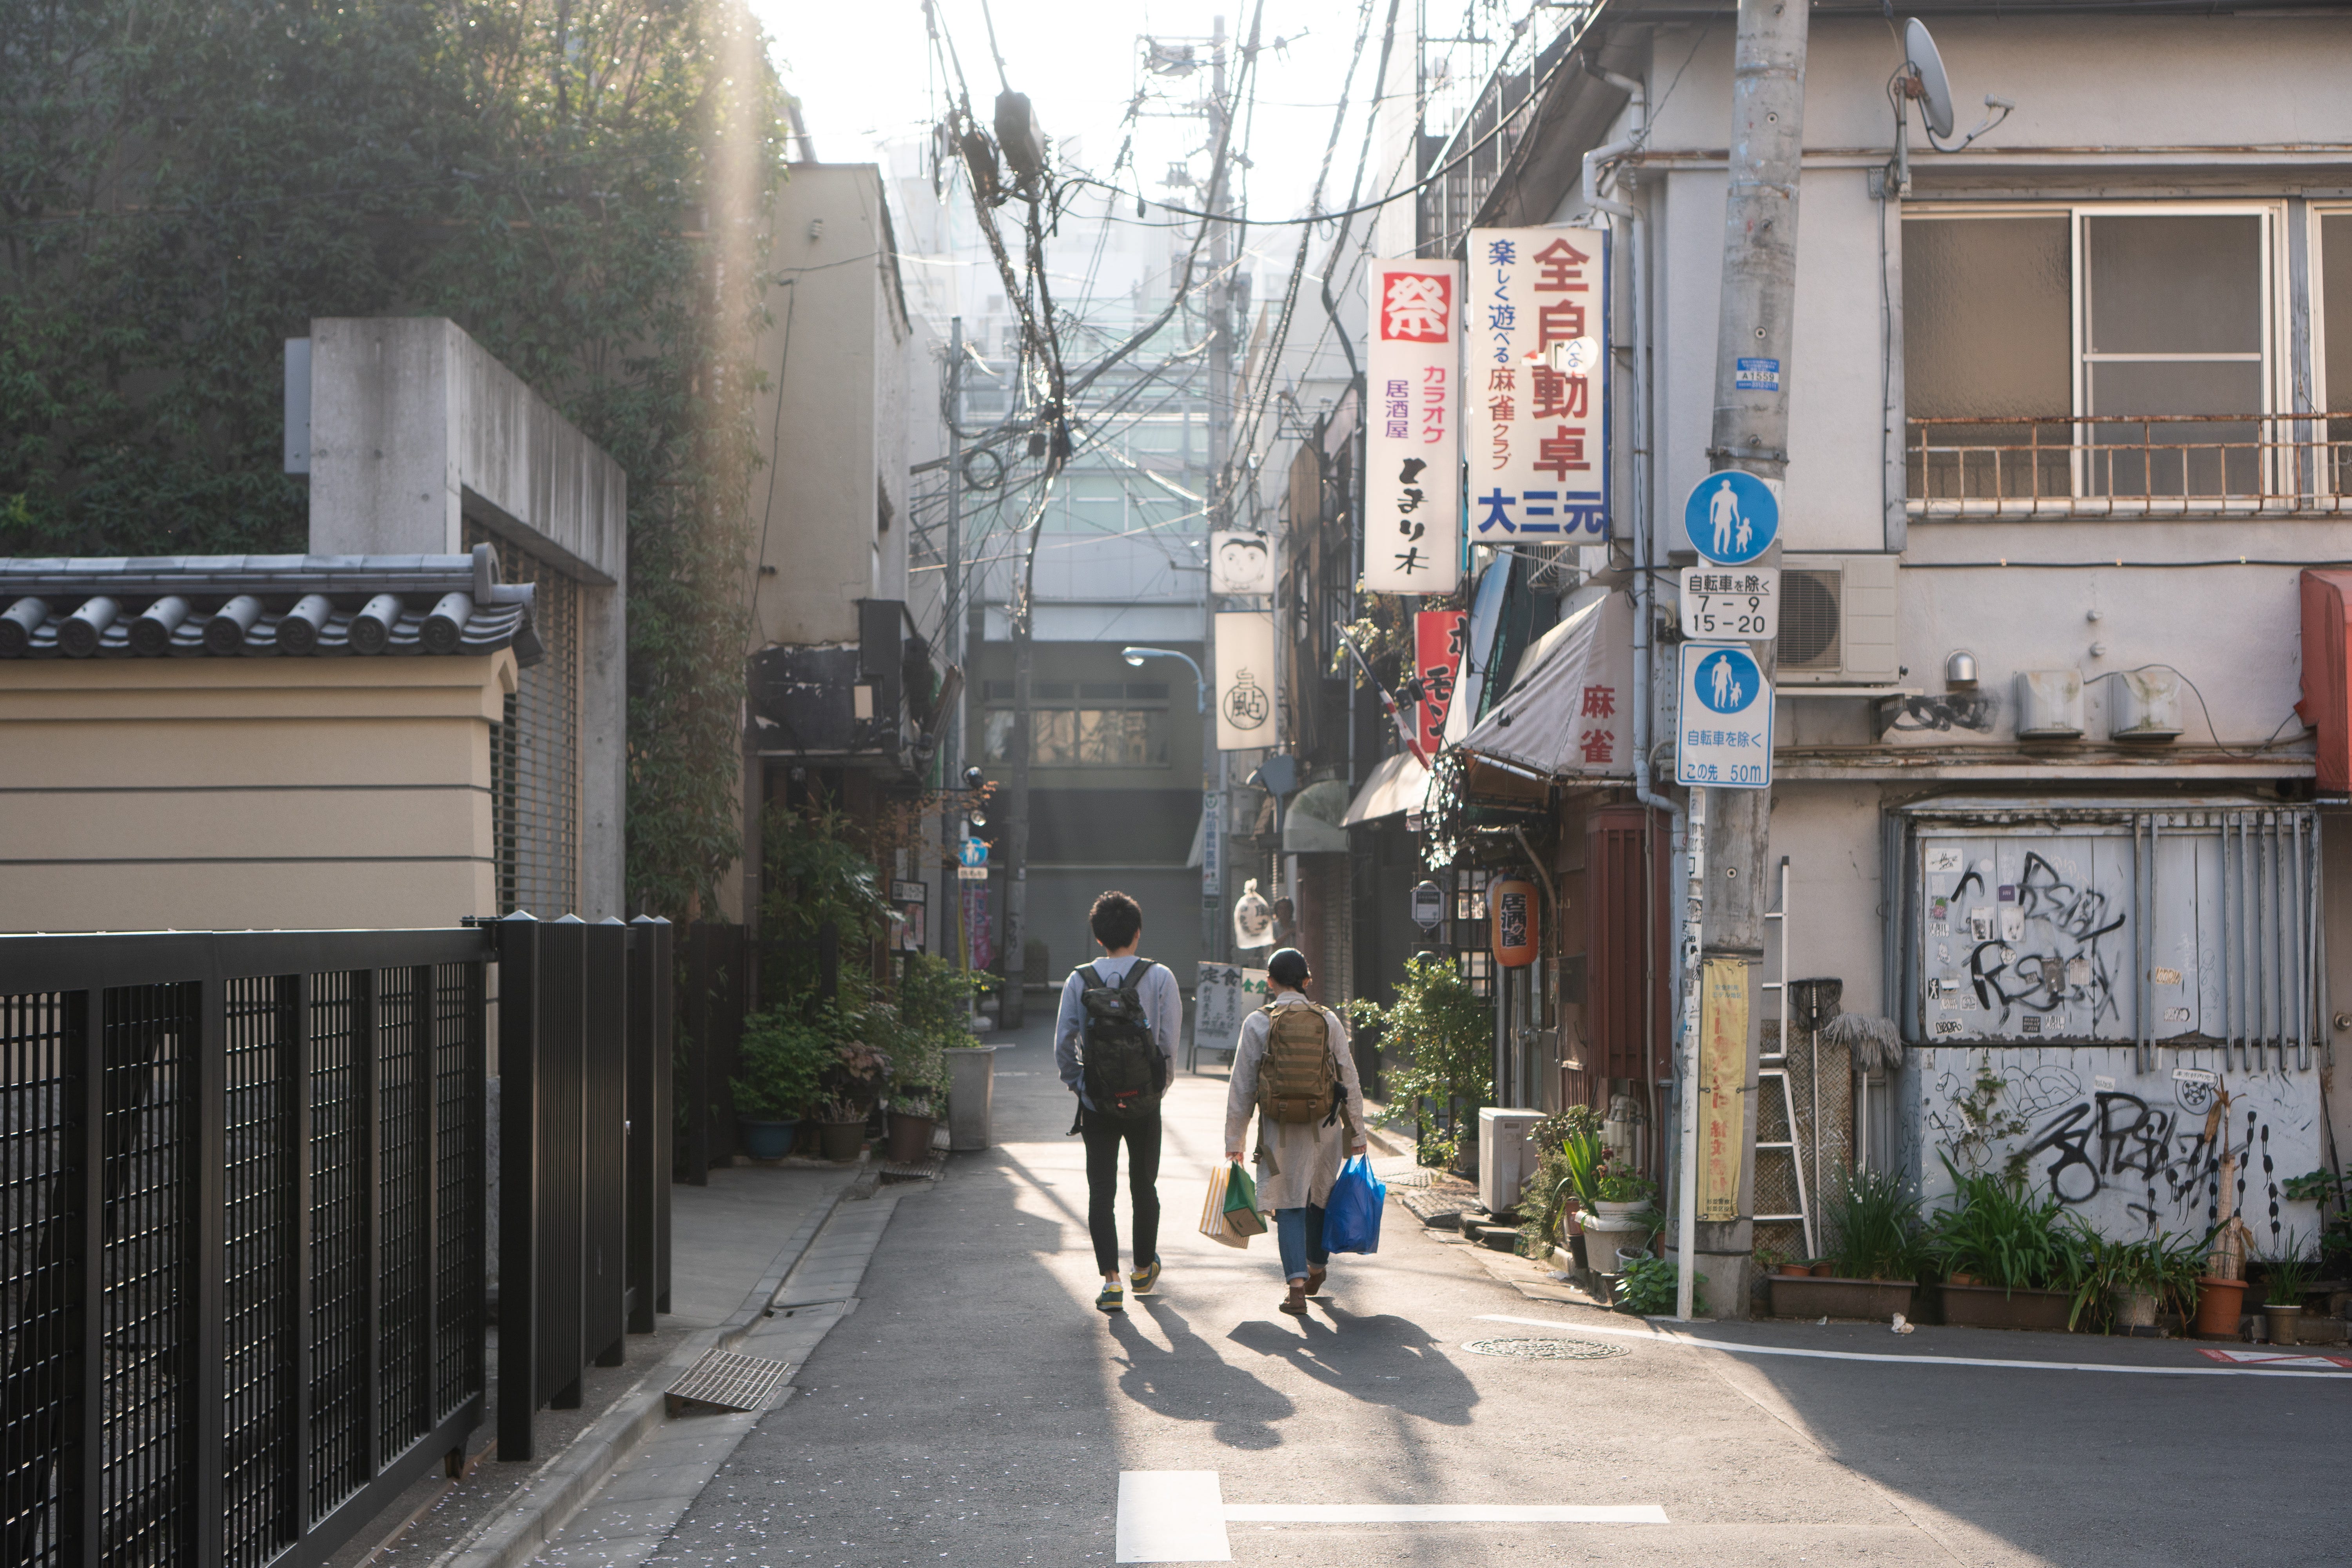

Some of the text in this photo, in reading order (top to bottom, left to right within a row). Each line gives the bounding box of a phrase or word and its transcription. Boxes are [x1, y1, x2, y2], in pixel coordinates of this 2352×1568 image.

[1386, 276, 1447, 338] 祭
[1488, 239, 1516, 470] 楽しく遊べる麻雀クラブ
[1532, 238, 1592, 482] 全自動卓
[1743, 372, 1774, 381] A1559
[1385, 380, 1409, 439] 居酒屋
[1423, 366, 1445, 444] カラオケ
[1394, 458, 1430, 575] とまり木
[1477, 487, 1604, 534] 大三元
[1690, 574, 1769, 592] 自転車を除く
[1581, 685, 1615, 763] 麻雀
[1688, 730, 1761, 748] 自転車を除く
[1687, 764, 1761, 782] この先 50m
[1501, 894, 1526, 946] 居酒屋
[1201, 967, 1241, 985] 定食
